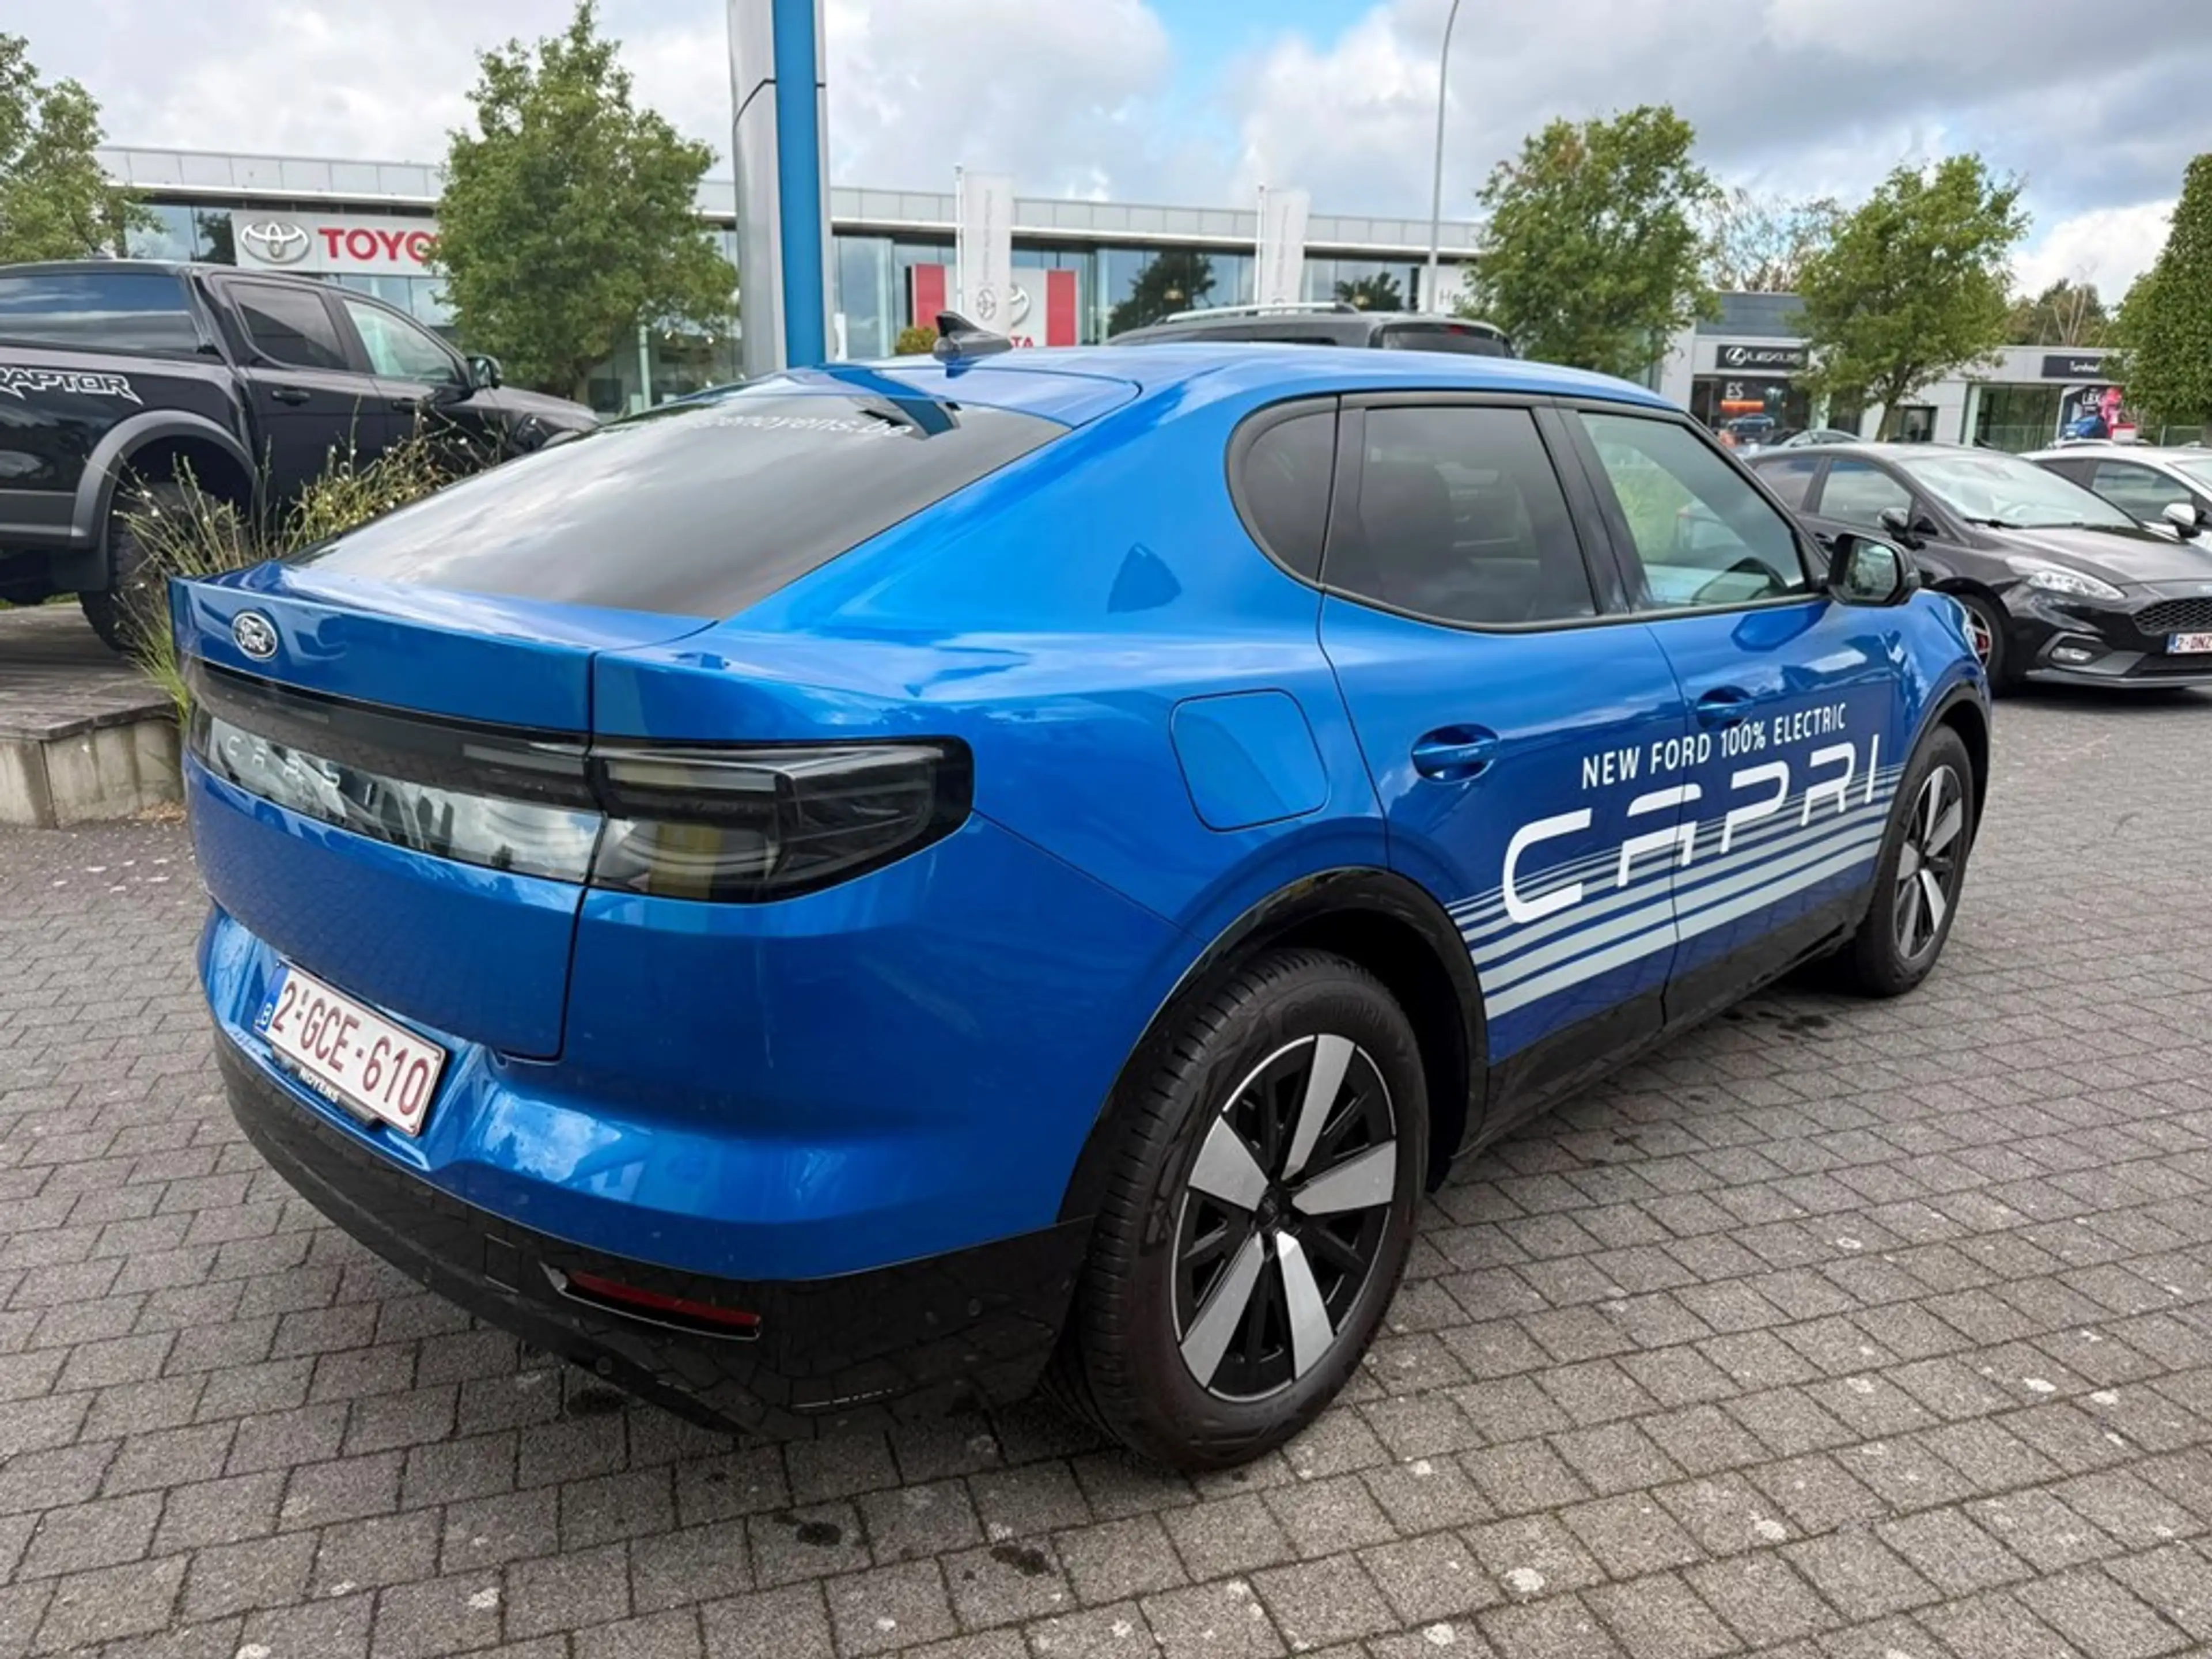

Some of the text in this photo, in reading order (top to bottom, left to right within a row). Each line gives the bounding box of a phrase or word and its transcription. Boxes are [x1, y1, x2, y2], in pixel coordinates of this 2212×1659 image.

[318, 228, 438, 265] TOYO
[1725, 382, 1744, 400] ES
[1582, 702, 1847, 790] NEW FORD 100% ELECTRIC
[1503, 733, 1880, 923] CAPRI
